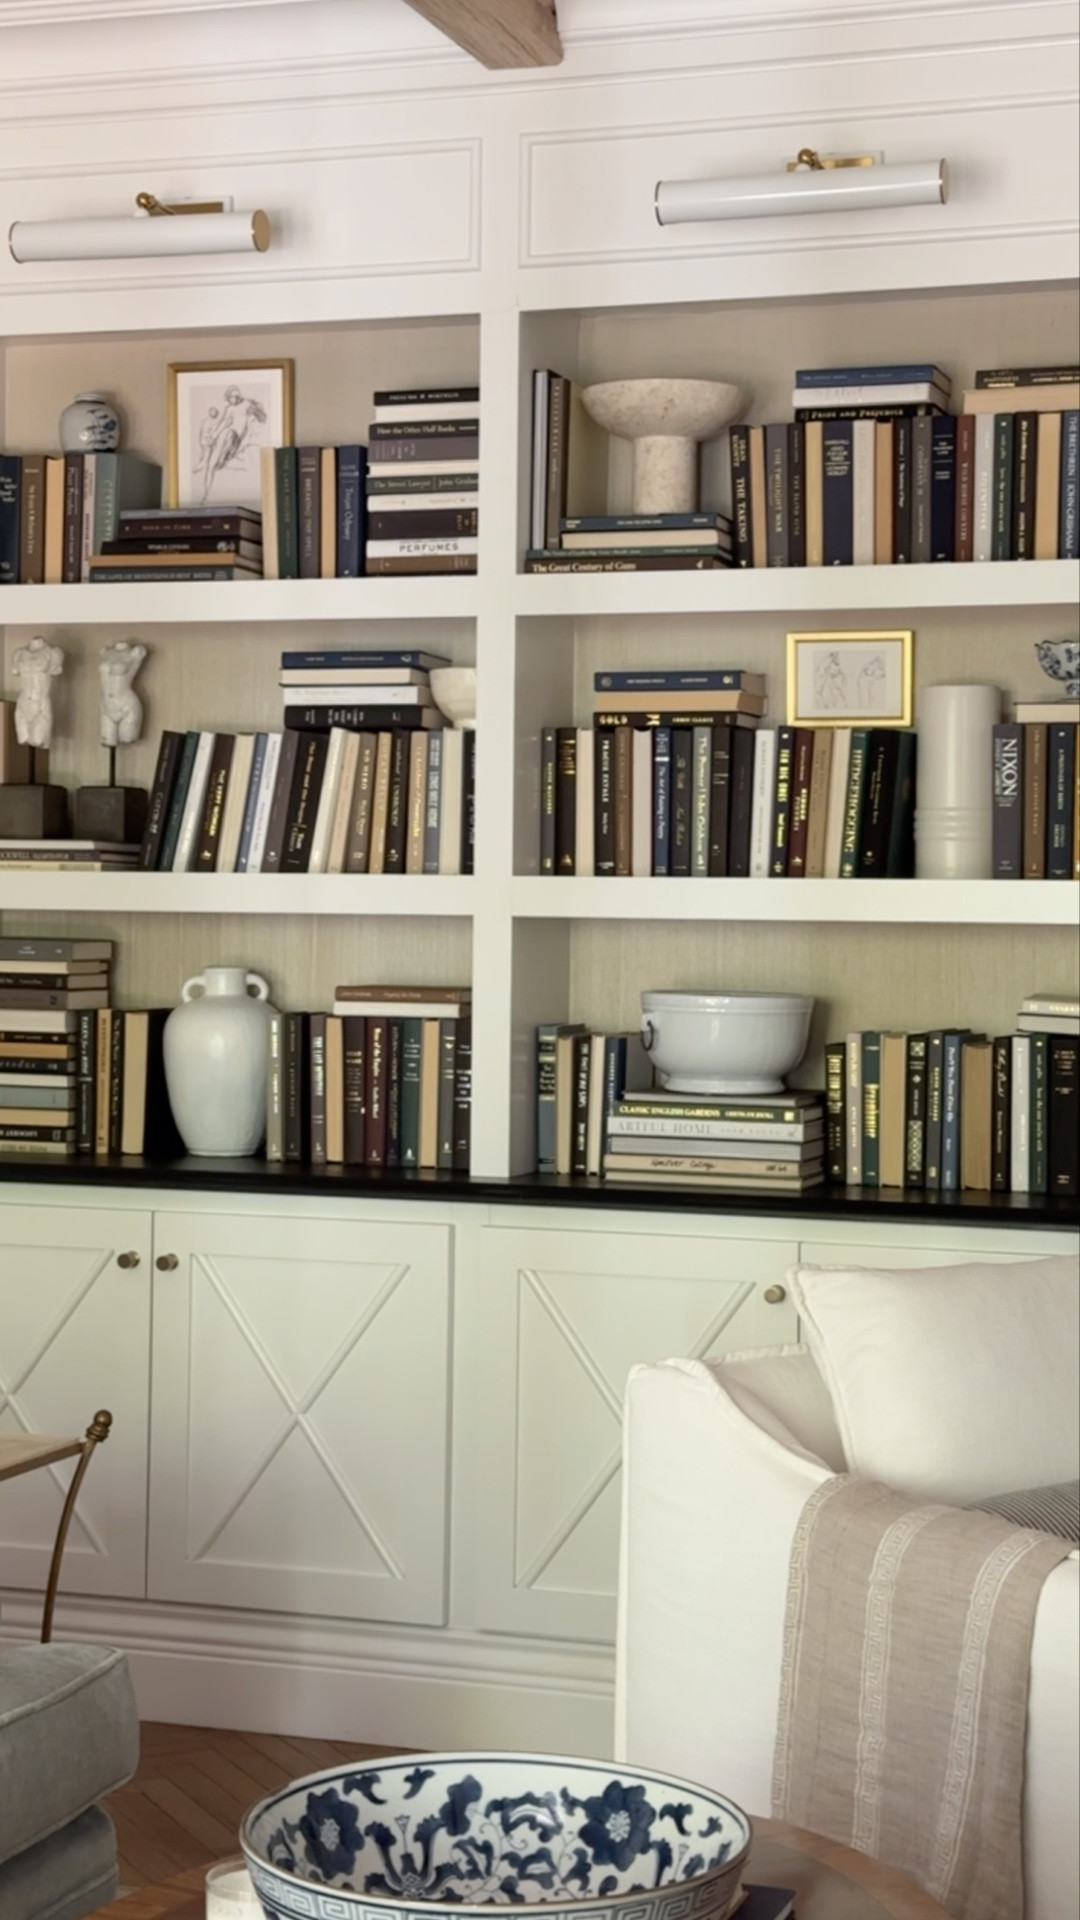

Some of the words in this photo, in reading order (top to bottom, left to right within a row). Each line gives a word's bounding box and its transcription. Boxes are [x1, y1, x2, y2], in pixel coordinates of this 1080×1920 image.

[811, 410, 838, 419] PRIDE
[860, 409, 904, 417] PREJUDICE
[377, 426, 391, 434] How
[393, 426, 402, 434] the
[423, 425, 437, 433] Half
[1068, 417, 1077, 432] THE
[1068, 434, 1076, 476] BRETHREN
[408, 480, 431, 489] Lawyer
[439, 478, 453, 488] John
[736, 477, 745, 499] THE
[774, 468, 782, 511] TWILIGHT
[343, 488, 353, 509] Trojan
[1067, 484, 1075, 507] JOHN
[343, 511, 353, 540] Odyssey
[737, 502, 747, 543] TAKING
[1066, 508, 1075, 549] GRISHAM
[399, 543, 459, 552] PERFUMES
[532, 564, 548, 572] The
[549, 563, 570, 572] Great
[573, 562, 603, 572] Century
[605, 562, 613, 570] of
[615, 562, 636, 570] Guns
[599, 715, 628, 724] GOLD
[699, 736, 707, 754] The
[364, 749, 371, 762] NO
[601, 740, 609, 771] PRAGUE
[780, 749, 789, 763] TEN
[697, 756, 707, 787] Partner
[778, 766, 789, 780] BIG
[1002, 738, 1018, 796] NIXON
[361, 765, 369, 790] HERO
[429, 771, 438, 789] LONG
[601, 773, 609, 803] FATALE
[777, 782, 788, 802] ONES
[428, 791, 438, 807] MILE
[657, 795, 665, 815] Raising
[697, 794, 705, 814] John
[843, 749, 863, 853] HEDGEHOGGING
[209, 806, 220, 837] WOMAN
[427, 808, 438, 828] HOME
[657, 821, 665, 840] Puppy
[696, 816, 705, 852] Grisham
[296, 833, 304, 849] Tom
[619, 1105, 650, 1115] CLASSIC
[650, 1107, 684, 1116] ENGLISH
[685, 1108, 721, 1118] GARDENS
[617, 1122, 669, 1134] ARTFUL
[672, 1123, 713, 1135] HOME
